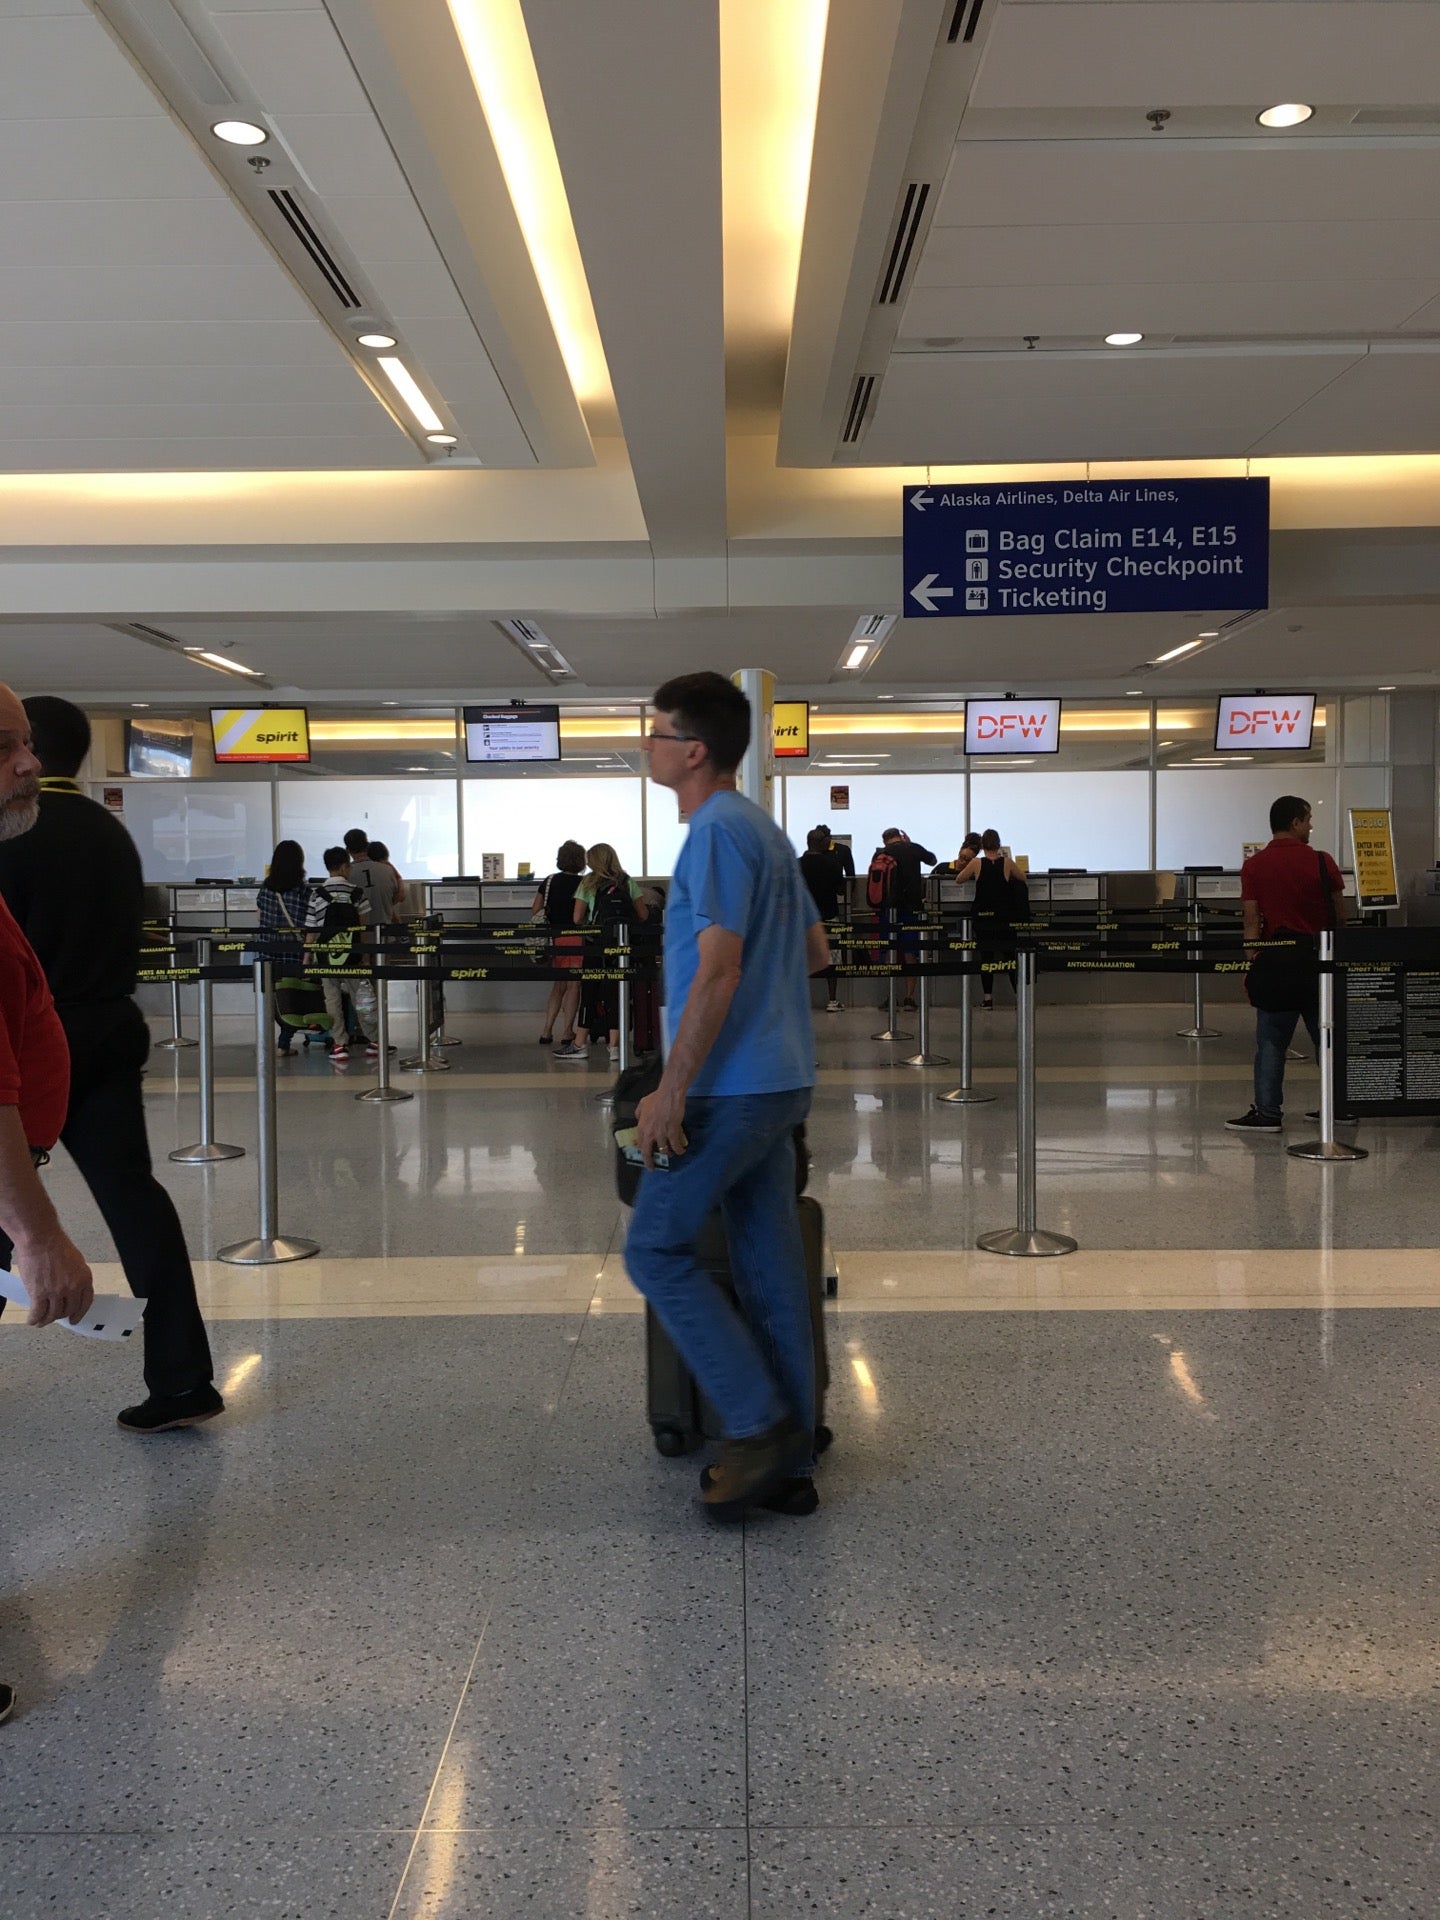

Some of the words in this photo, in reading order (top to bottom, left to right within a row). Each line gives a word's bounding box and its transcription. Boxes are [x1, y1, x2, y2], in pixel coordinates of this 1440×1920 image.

[940, 492, 991, 507] Alaska
[995, 491, 1058, 505] Airlines,
[1063, 489, 1103, 503] Delta
[1108, 489, 1131, 502] Air
[1135, 488, 1179, 502] Lines,
[999, 531, 1045, 555] Bag
[1054, 528, 1122, 549] Claim
[1131, 527, 1183, 549] E14,
[1192, 525, 1237, 546] E15
[998, 557, 1098, 583] Security
[1106, 555, 1243, 581] Checkpoint
[998, 586, 1107, 611] Ticketing
[977, 714, 1047, 739] DFW
[1229, 709, 1301, 735] DFW
[774, 725, 799, 737] irit
[256, 731, 299, 744] spirit
[218, 943, 246, 952] spirit
[410, 945, 438, 953] spirit
[603, 946, 632, 955] spirit
[949, 941, 978, 950] spirit
[1151, 941, 1181, 950] spirit
[981, 960, 1017, 973] spirit
[1214, 961, 1253, 972] spirit
[450, 968, 489, 979] spirit
